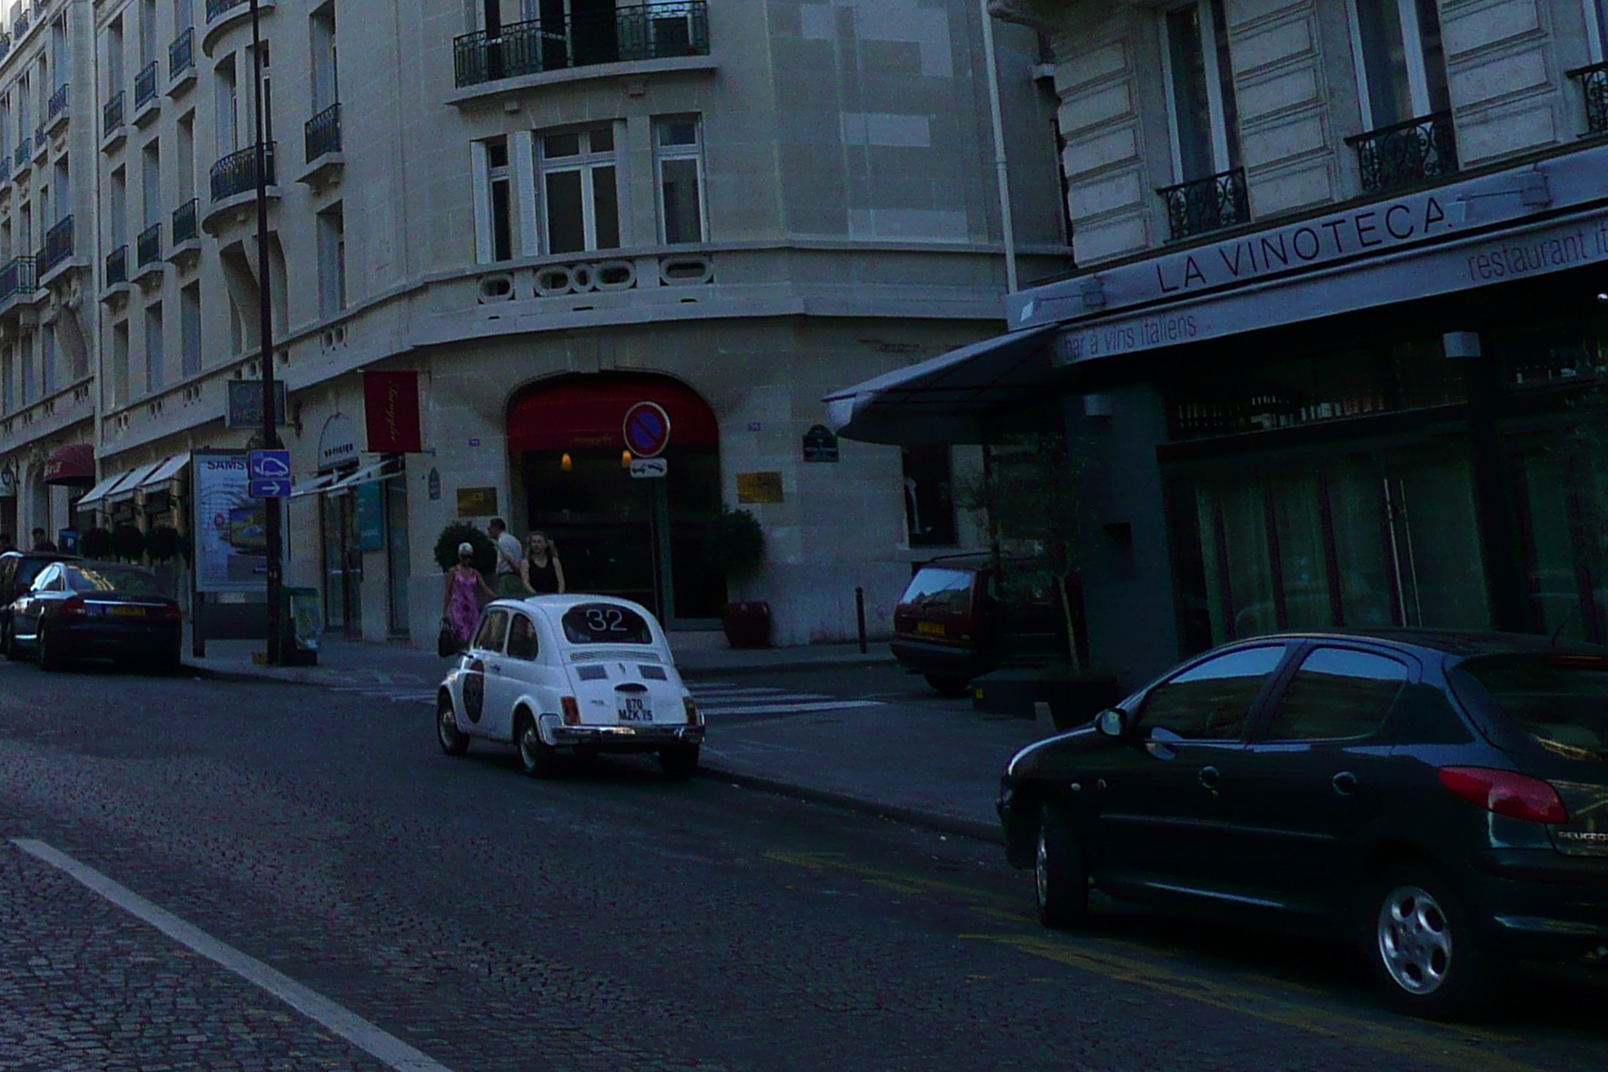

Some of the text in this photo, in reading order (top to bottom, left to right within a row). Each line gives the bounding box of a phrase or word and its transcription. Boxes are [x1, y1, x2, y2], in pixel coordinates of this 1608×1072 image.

[1468, 228, 1589, 283] restaurant
[1157, 256, 1207, 293] LA
[1105, 325, 1135, 352] vins
[1139, 314, 1198, 347] italiens
[586, 608, 628, 632] 32
[625, 698, 643, 710] 870
